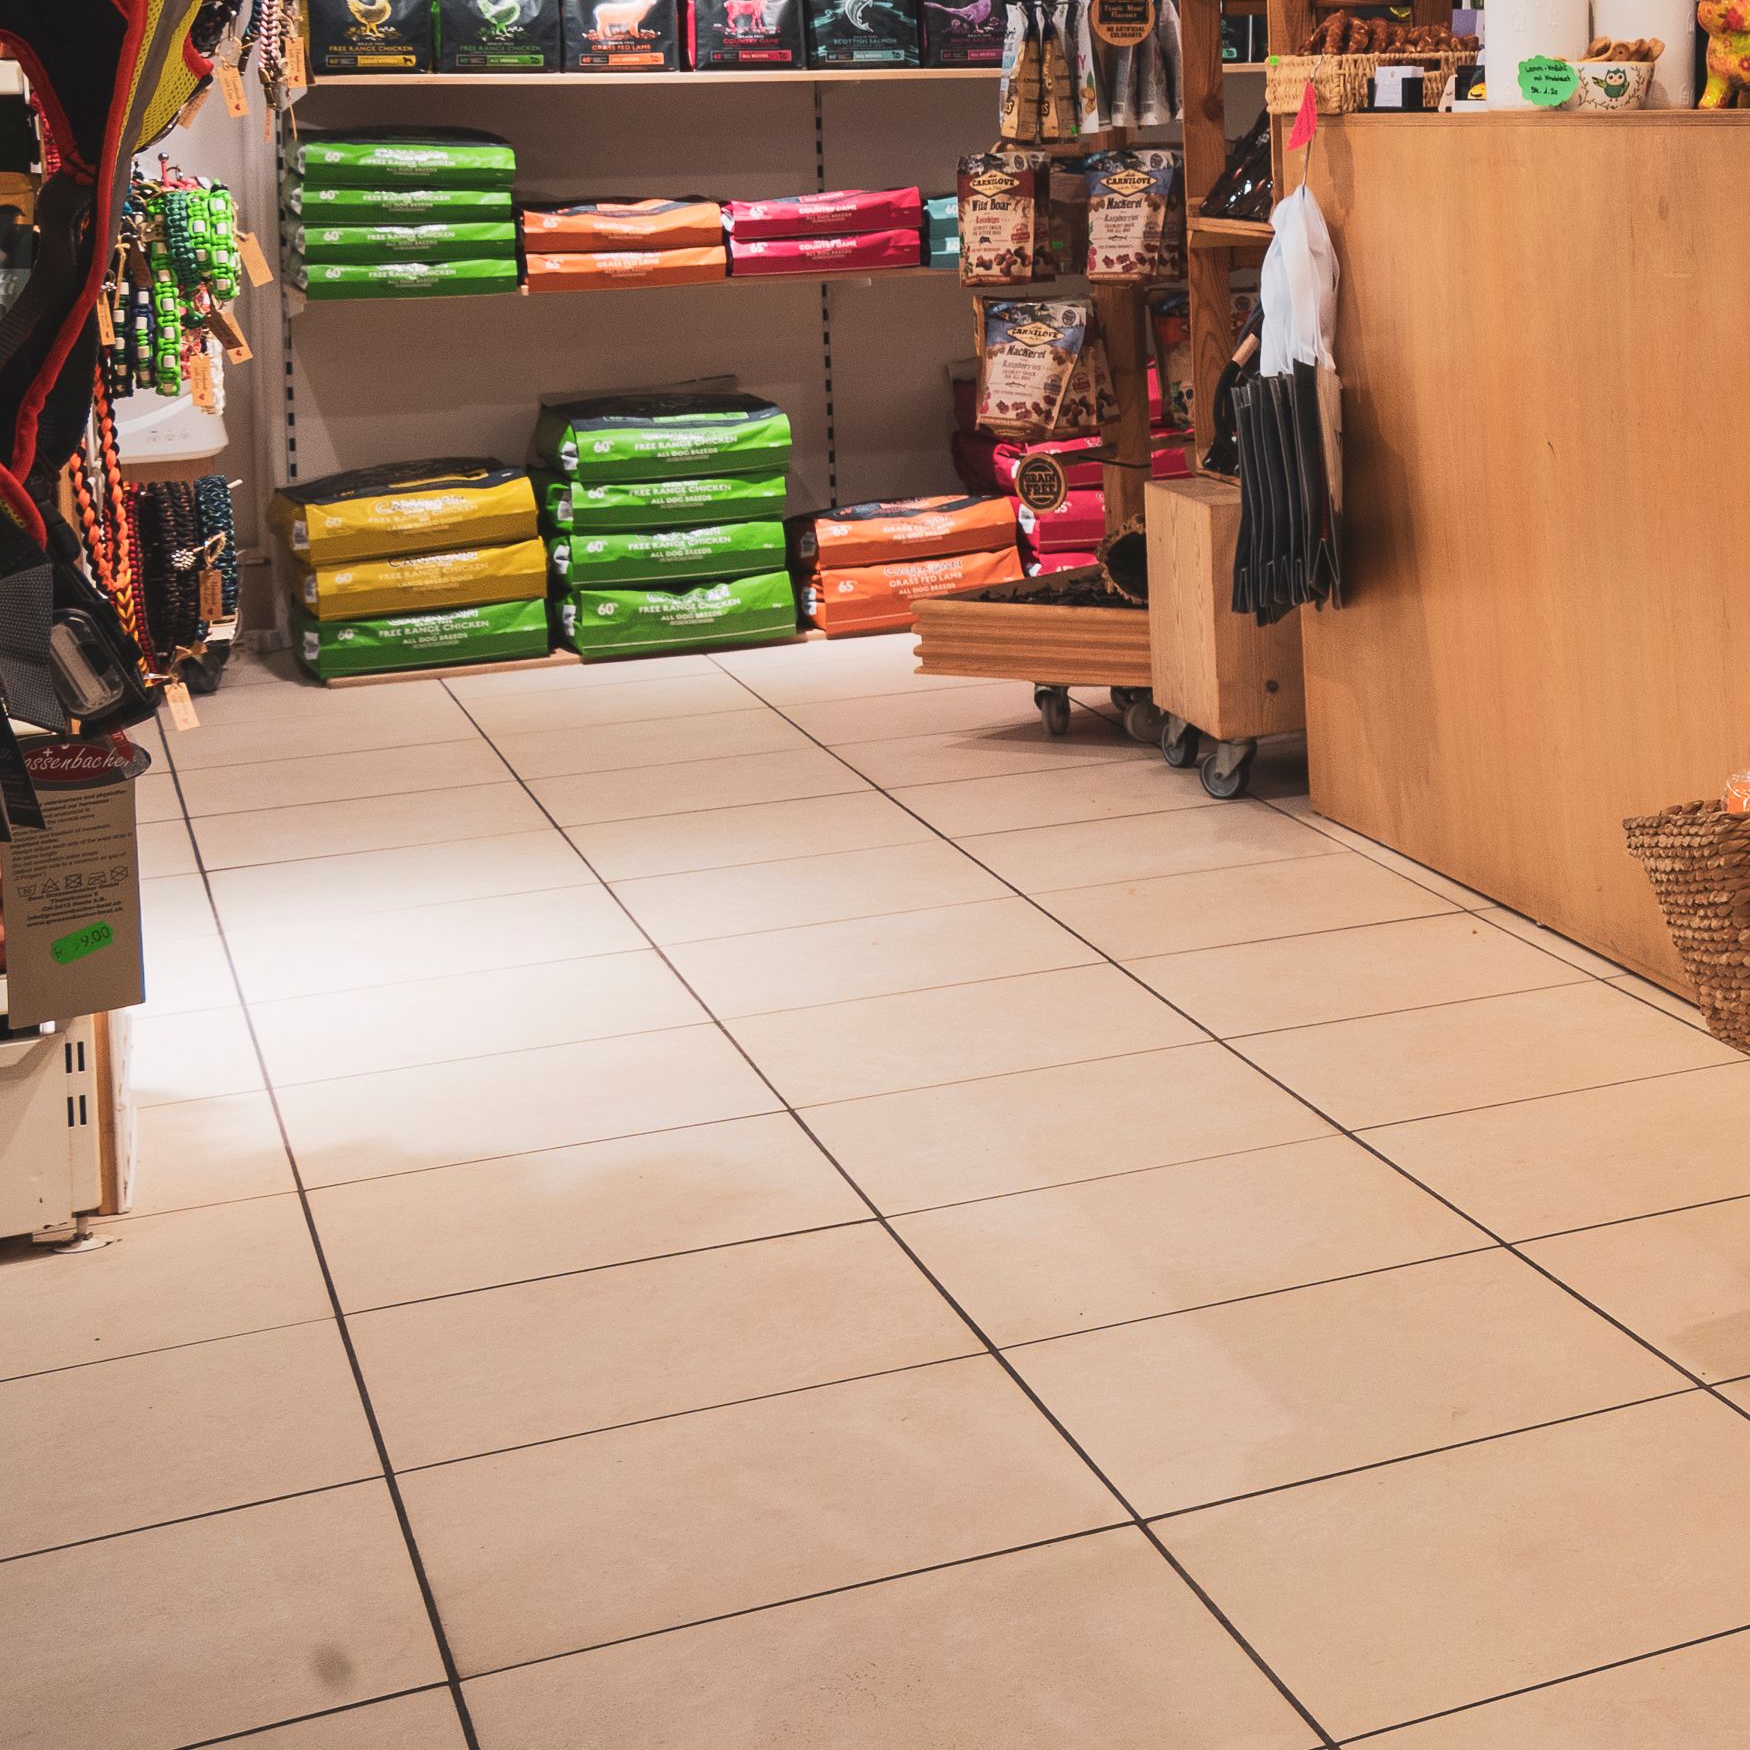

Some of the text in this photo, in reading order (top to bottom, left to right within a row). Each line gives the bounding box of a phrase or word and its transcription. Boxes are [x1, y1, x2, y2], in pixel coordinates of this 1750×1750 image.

[1024, 473, 1057, 488] GRAIN
[1026, 482, 1057, 497] FREE
[638, 599, 741, 614] FREE RANGE CHICKEN
